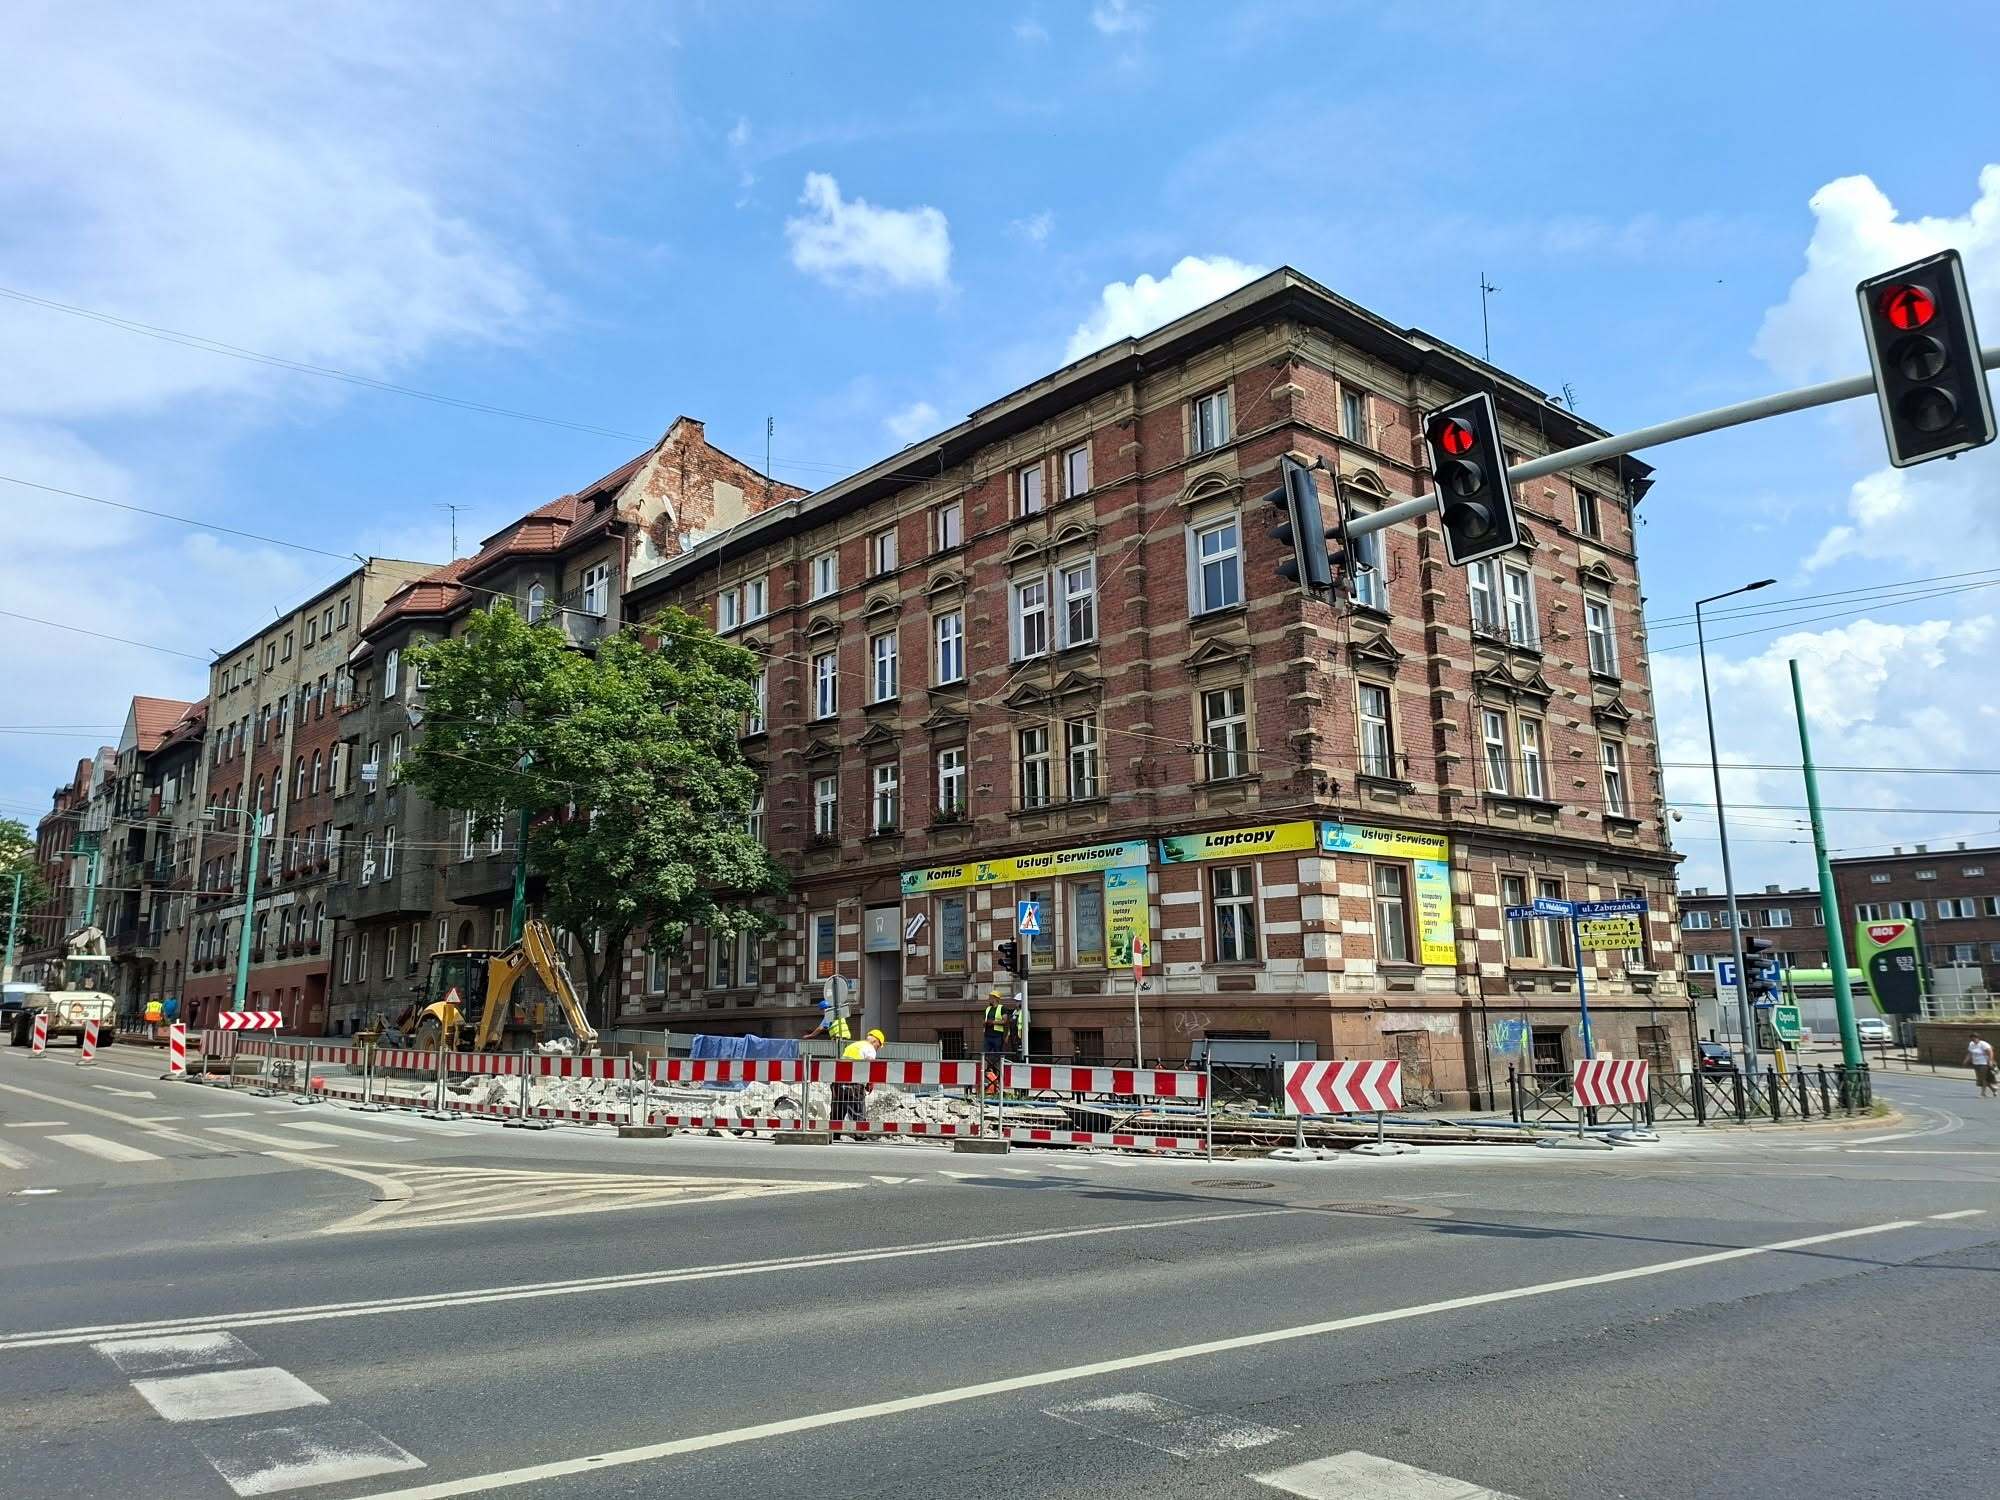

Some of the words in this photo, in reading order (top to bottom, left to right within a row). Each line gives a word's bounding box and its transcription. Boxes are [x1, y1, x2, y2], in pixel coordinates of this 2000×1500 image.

[1206, 830, 1275, 847] Laptopy
[1361, 829, 1393, 843] Usługi
[1395, 833, 1445, 847] Serwisowe
[1016, 854, 1053, 869] Usługi
[1056, 847, 1124, 864] Serwisowe
[926, 867, 962, 881] Komis
[1510, 909, 1520, 917] ul.
[1582, 904, 1592, 913] ul.
[1594, 902, 1641, 912] Zabrzańska
[1872, 927, 1893, 936] MOL
[1582, 937, 1637, 947] LAPTOPÓW
